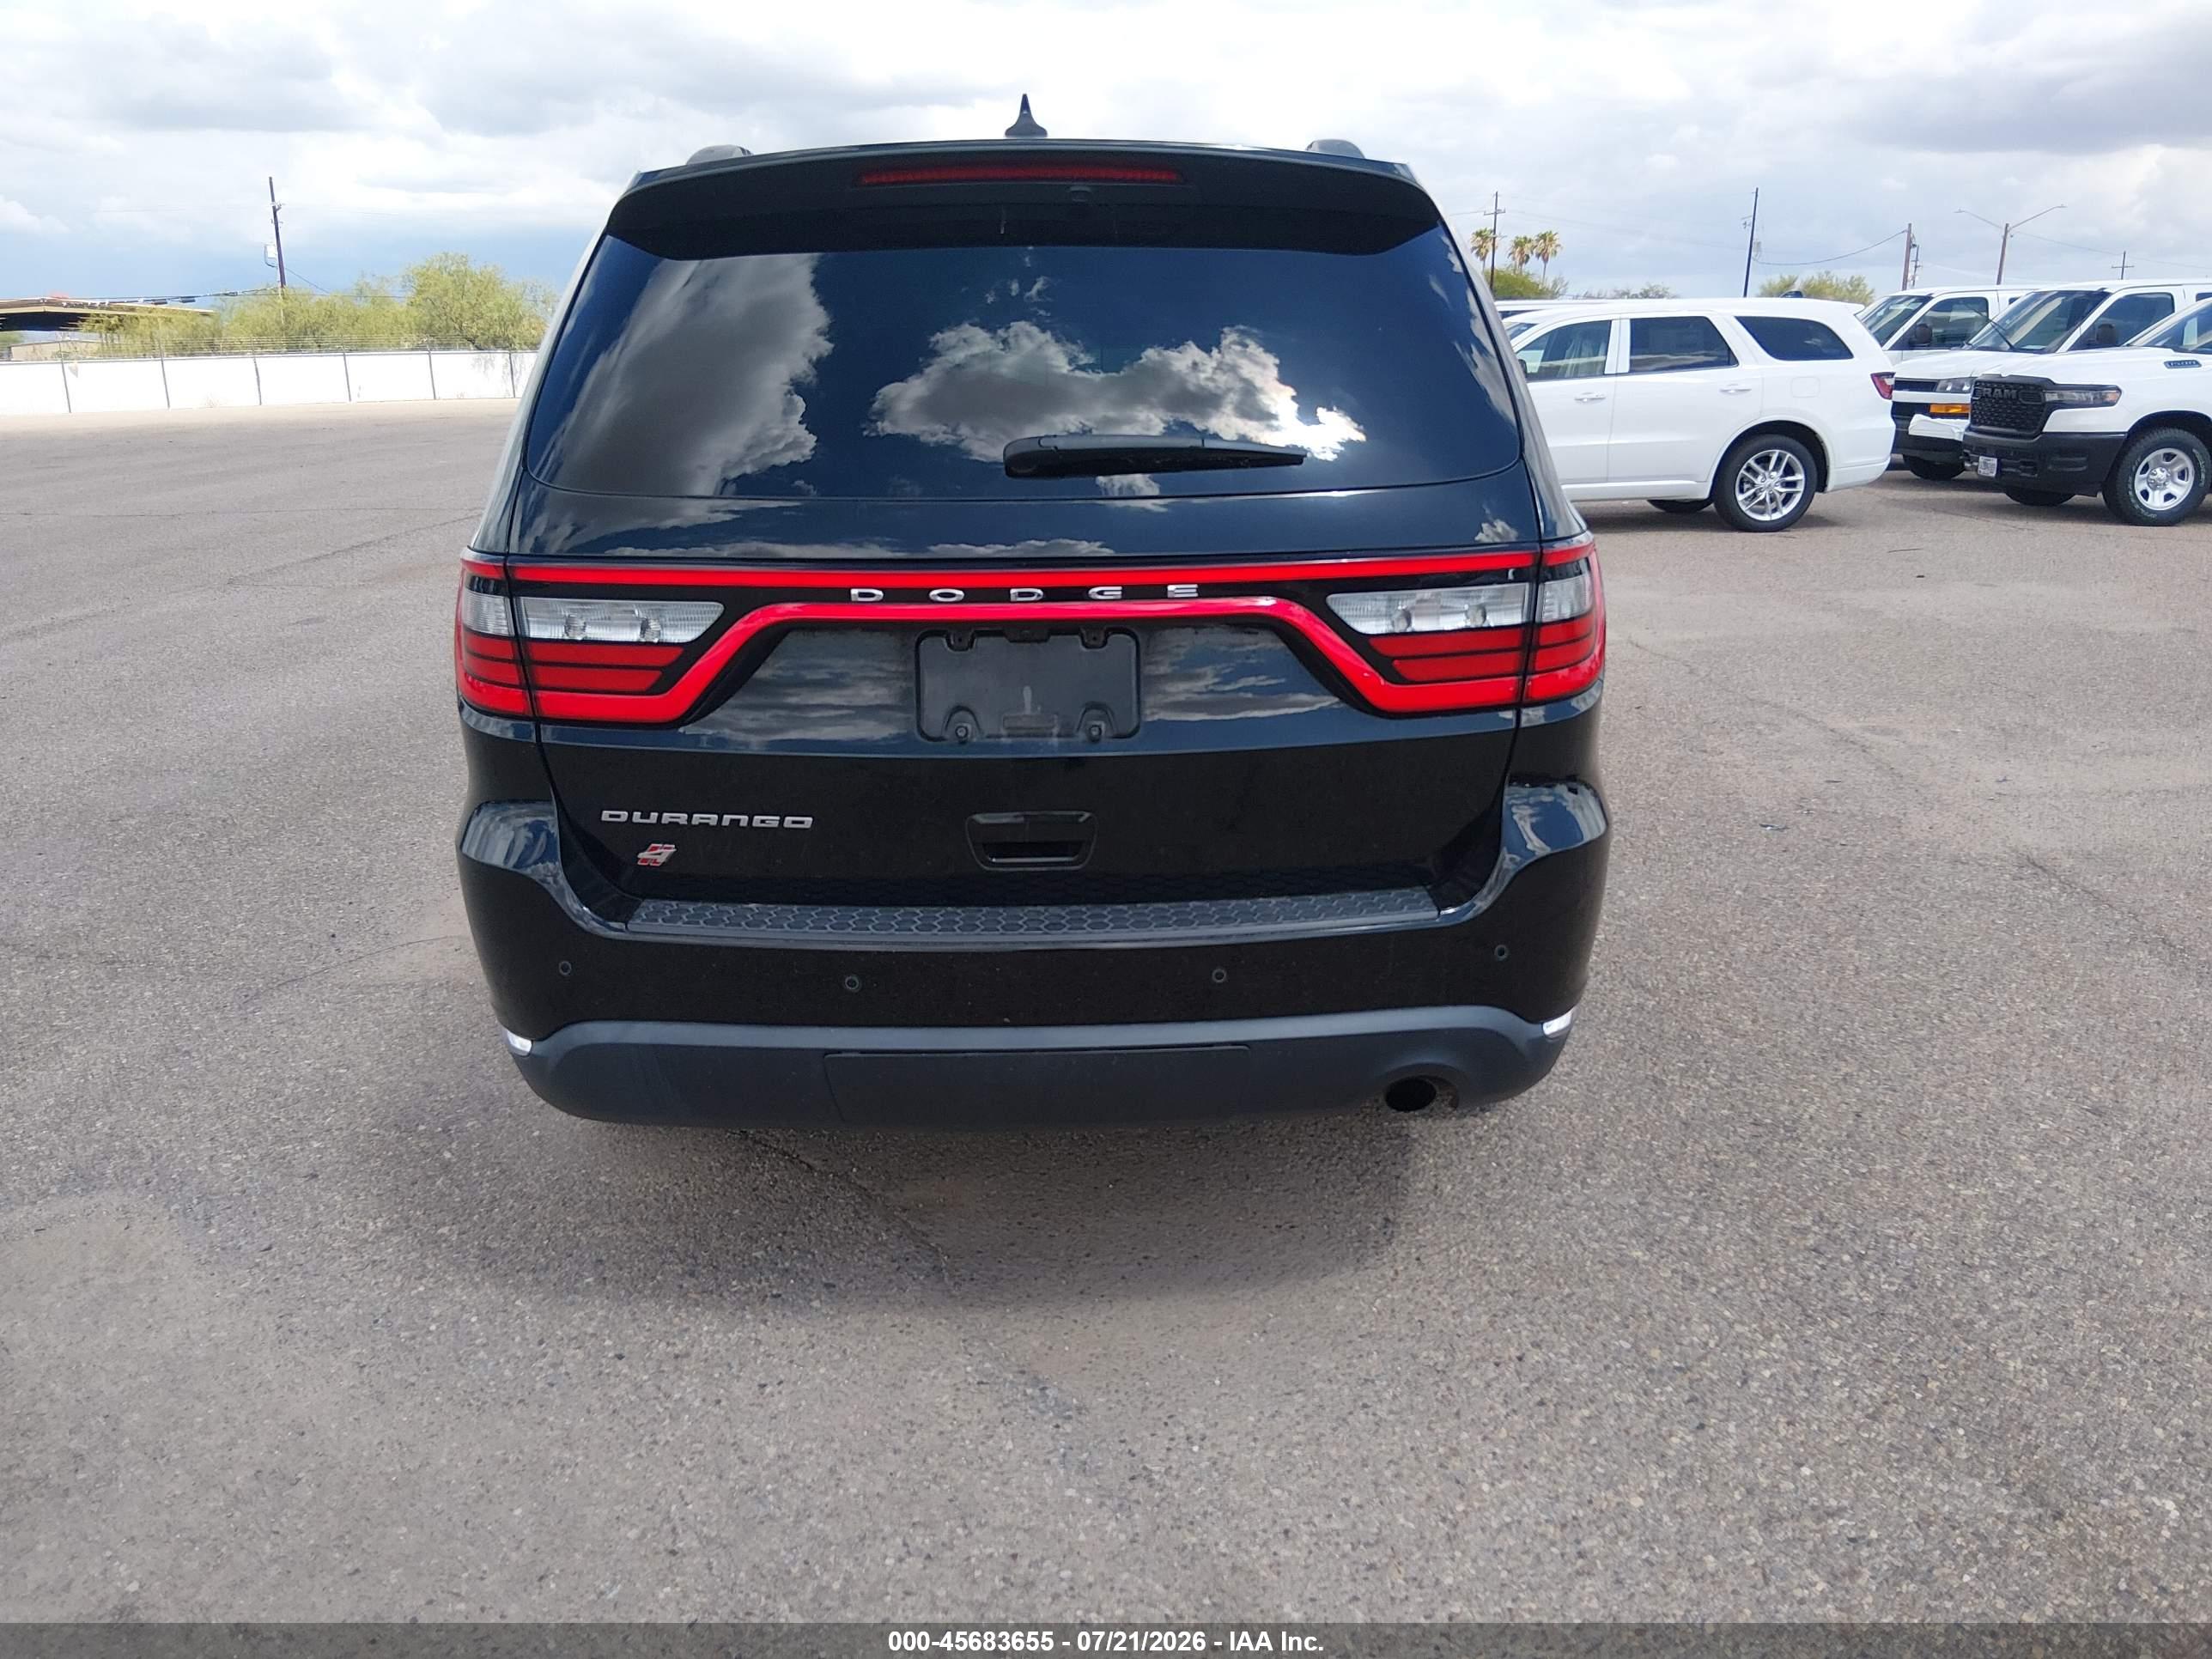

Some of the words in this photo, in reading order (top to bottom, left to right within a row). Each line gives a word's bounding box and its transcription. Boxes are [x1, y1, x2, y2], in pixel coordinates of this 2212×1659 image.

[1983, 387, 2017, 398] RAM
[849, 584, 1199, 602] DODGE
[601, 810, 814, 829] DURANGO
